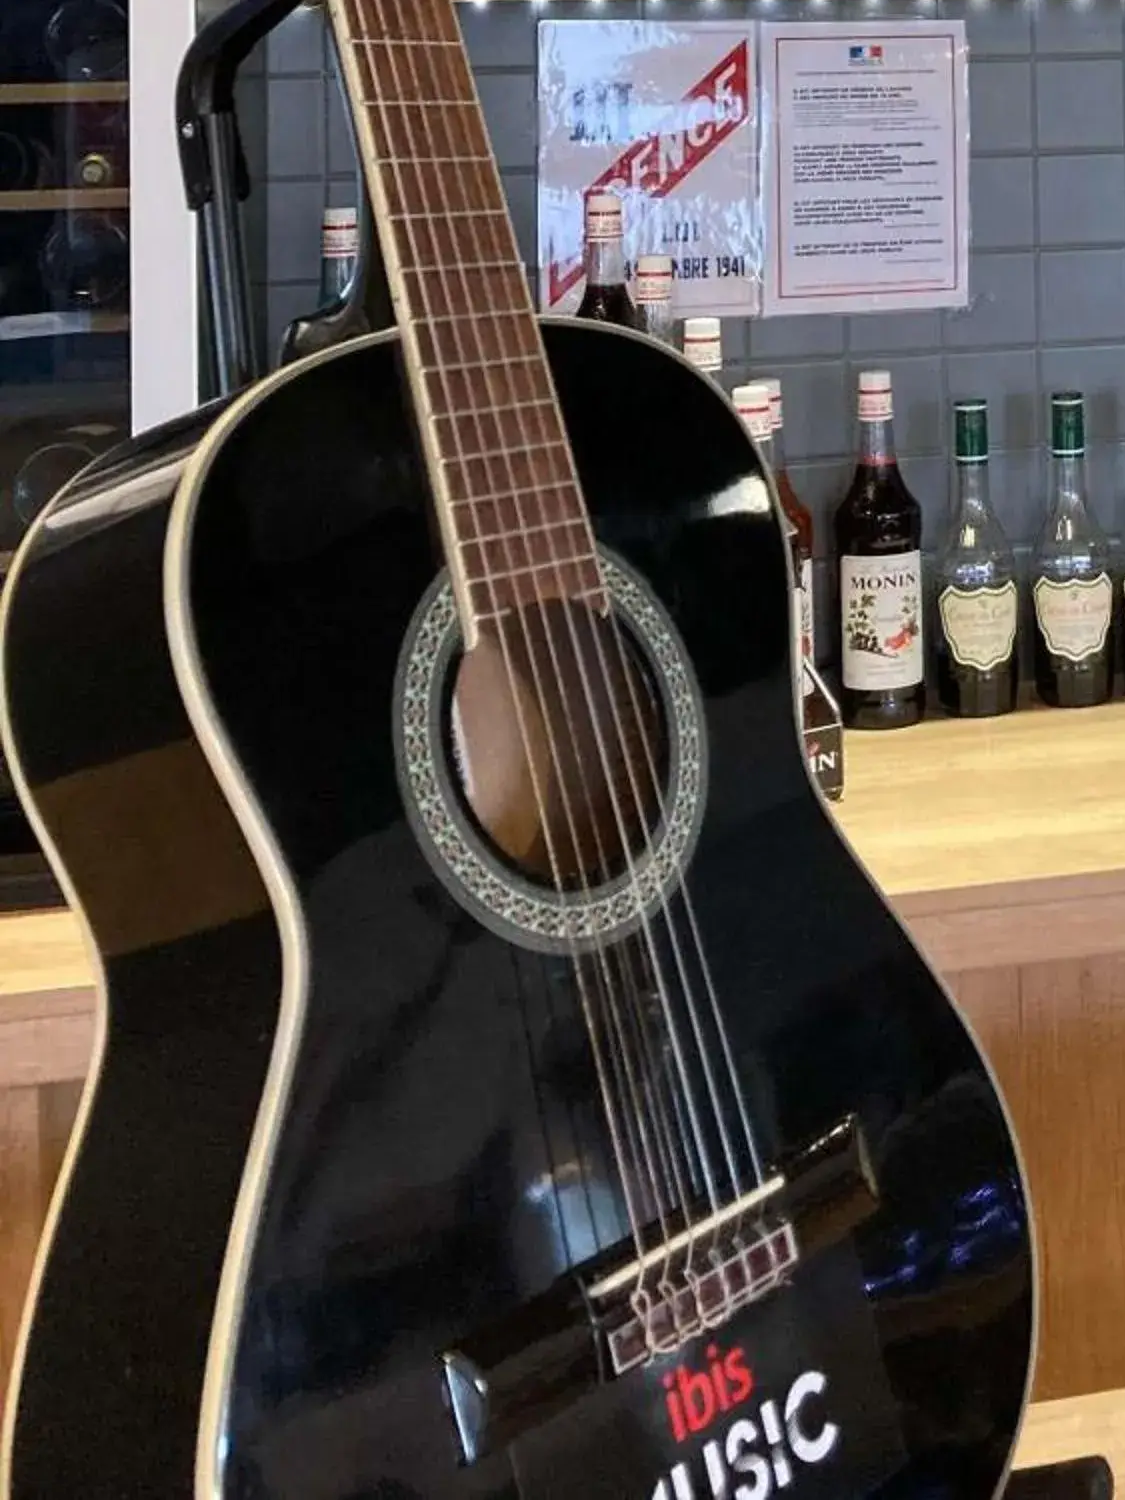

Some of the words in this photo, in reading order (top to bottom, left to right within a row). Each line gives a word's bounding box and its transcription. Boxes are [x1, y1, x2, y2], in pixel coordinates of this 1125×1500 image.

[851, 572, 916, 590] MONIN
[651, 1371, 838, 1500] USIC
[661, 1345, 754, 1443] ibis
